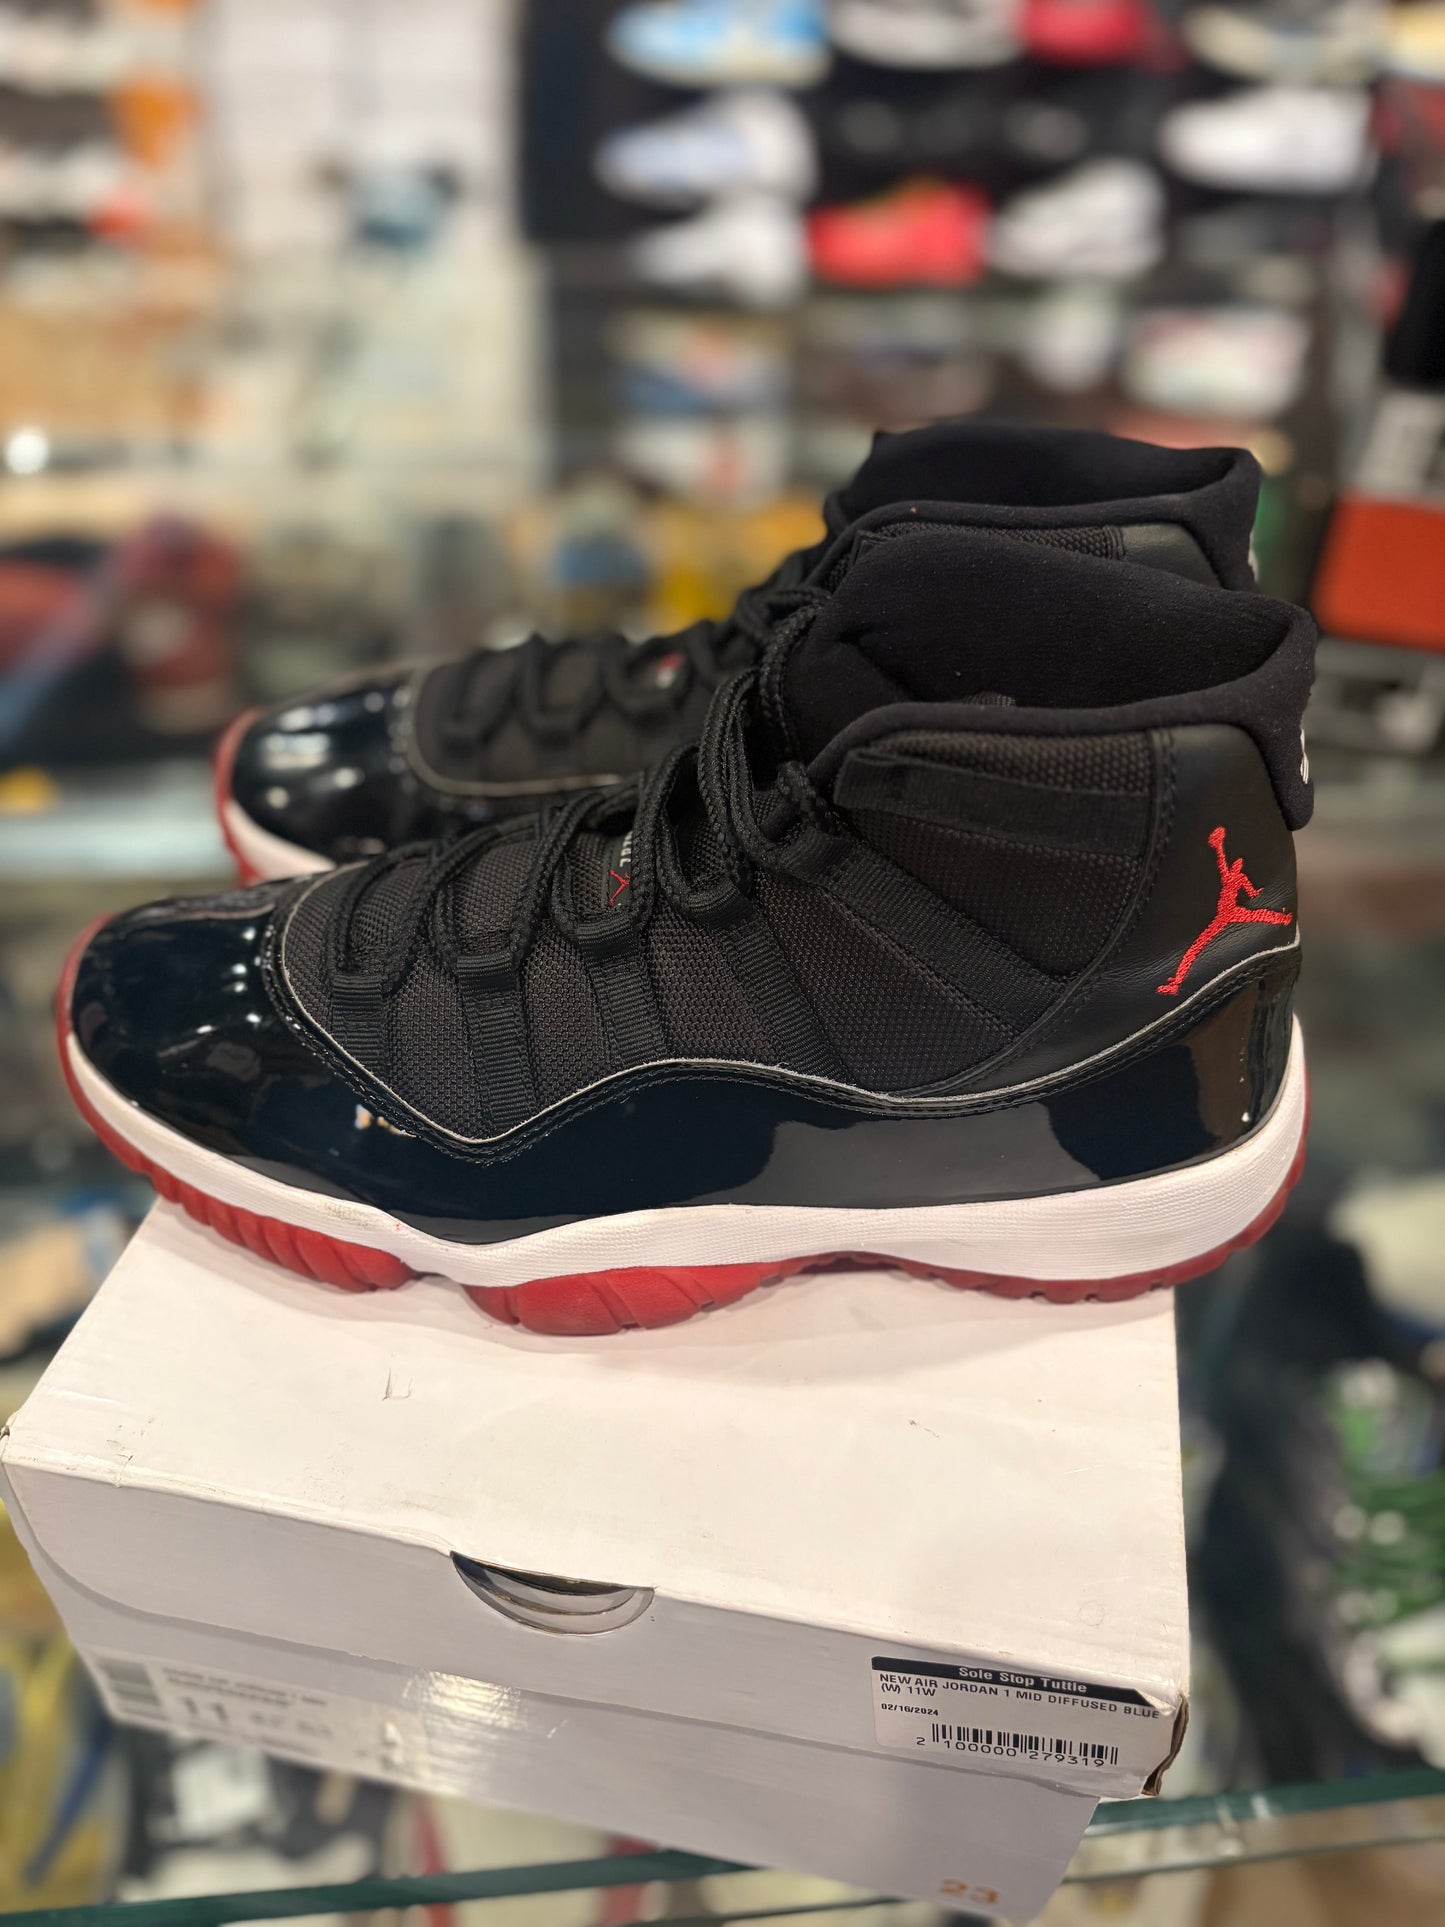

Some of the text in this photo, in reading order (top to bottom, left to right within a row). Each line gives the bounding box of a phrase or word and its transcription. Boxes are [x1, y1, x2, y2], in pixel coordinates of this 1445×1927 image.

[881, 1682, 936, 1697] (W) 11W
[958, 1666, 1087, 1693] Sole Stop Tuttle
[880, 1673, 1160, 1719] NEW AIR JORDAN 1 MID DIFFUSED BLUE
[881, 1703, 939, 1716] 02/16/2024
[916, 1736, 1104, 1768] 2 100000 279319
